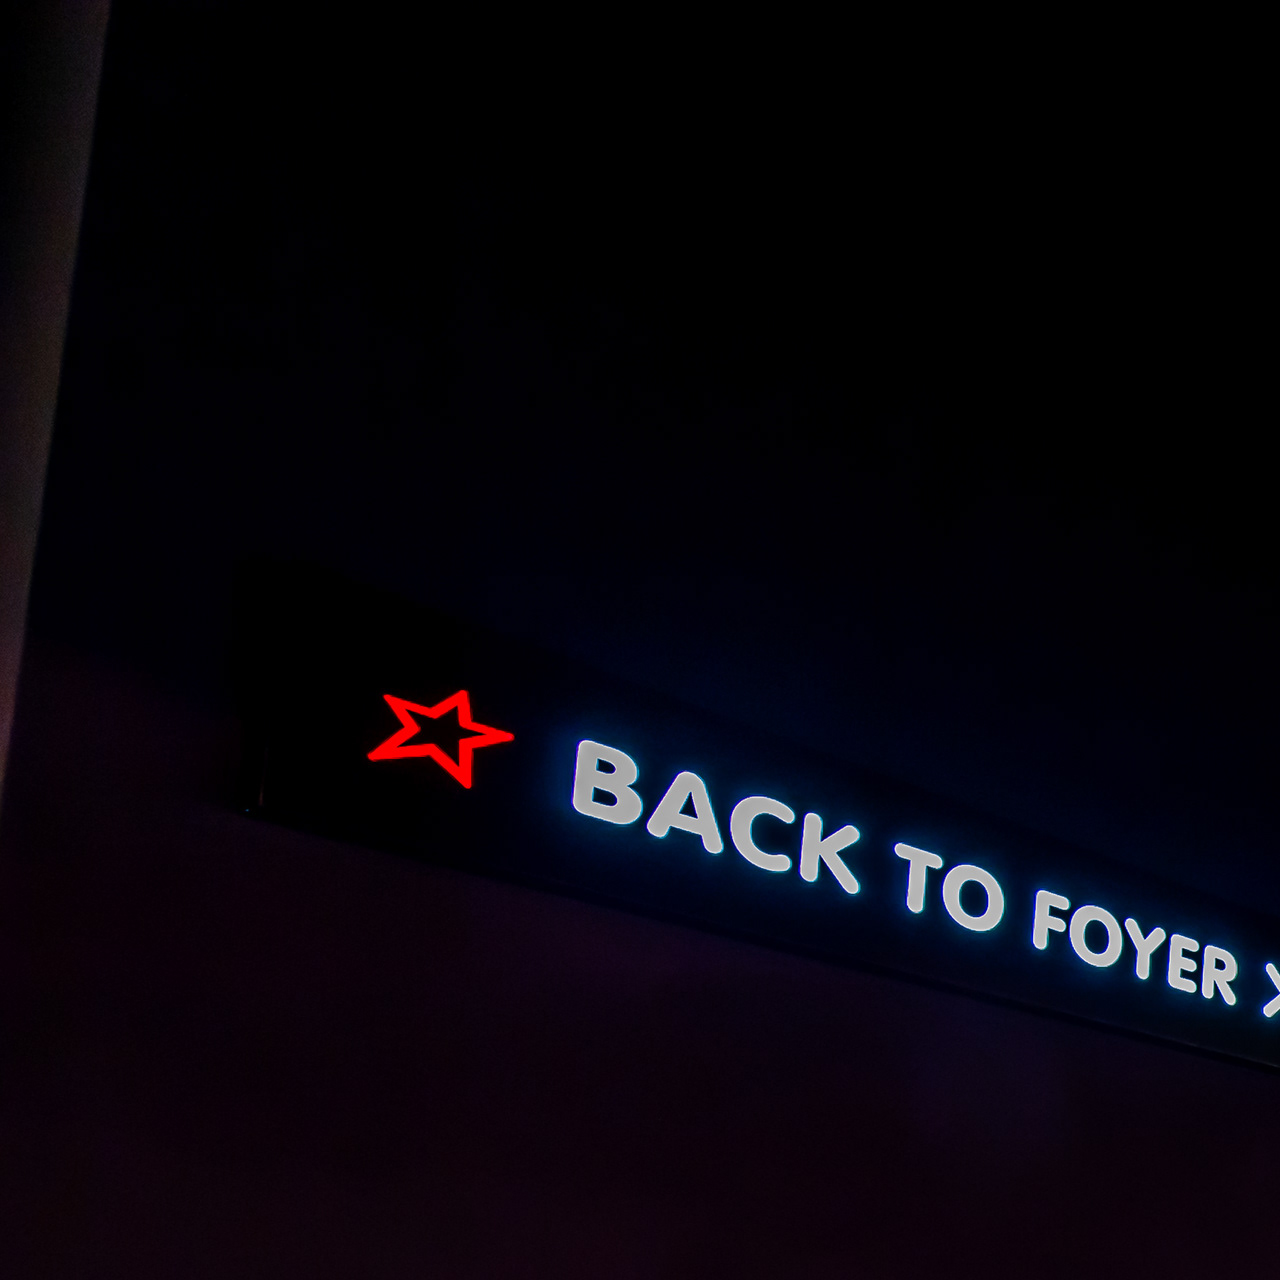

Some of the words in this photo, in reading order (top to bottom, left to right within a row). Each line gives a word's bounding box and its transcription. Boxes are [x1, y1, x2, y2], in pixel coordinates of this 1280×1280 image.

[570, 738, 862, 896] BACK
[893, 841, 1006, 934] TO
[1032, 889, 1238, 1008] FOYER
